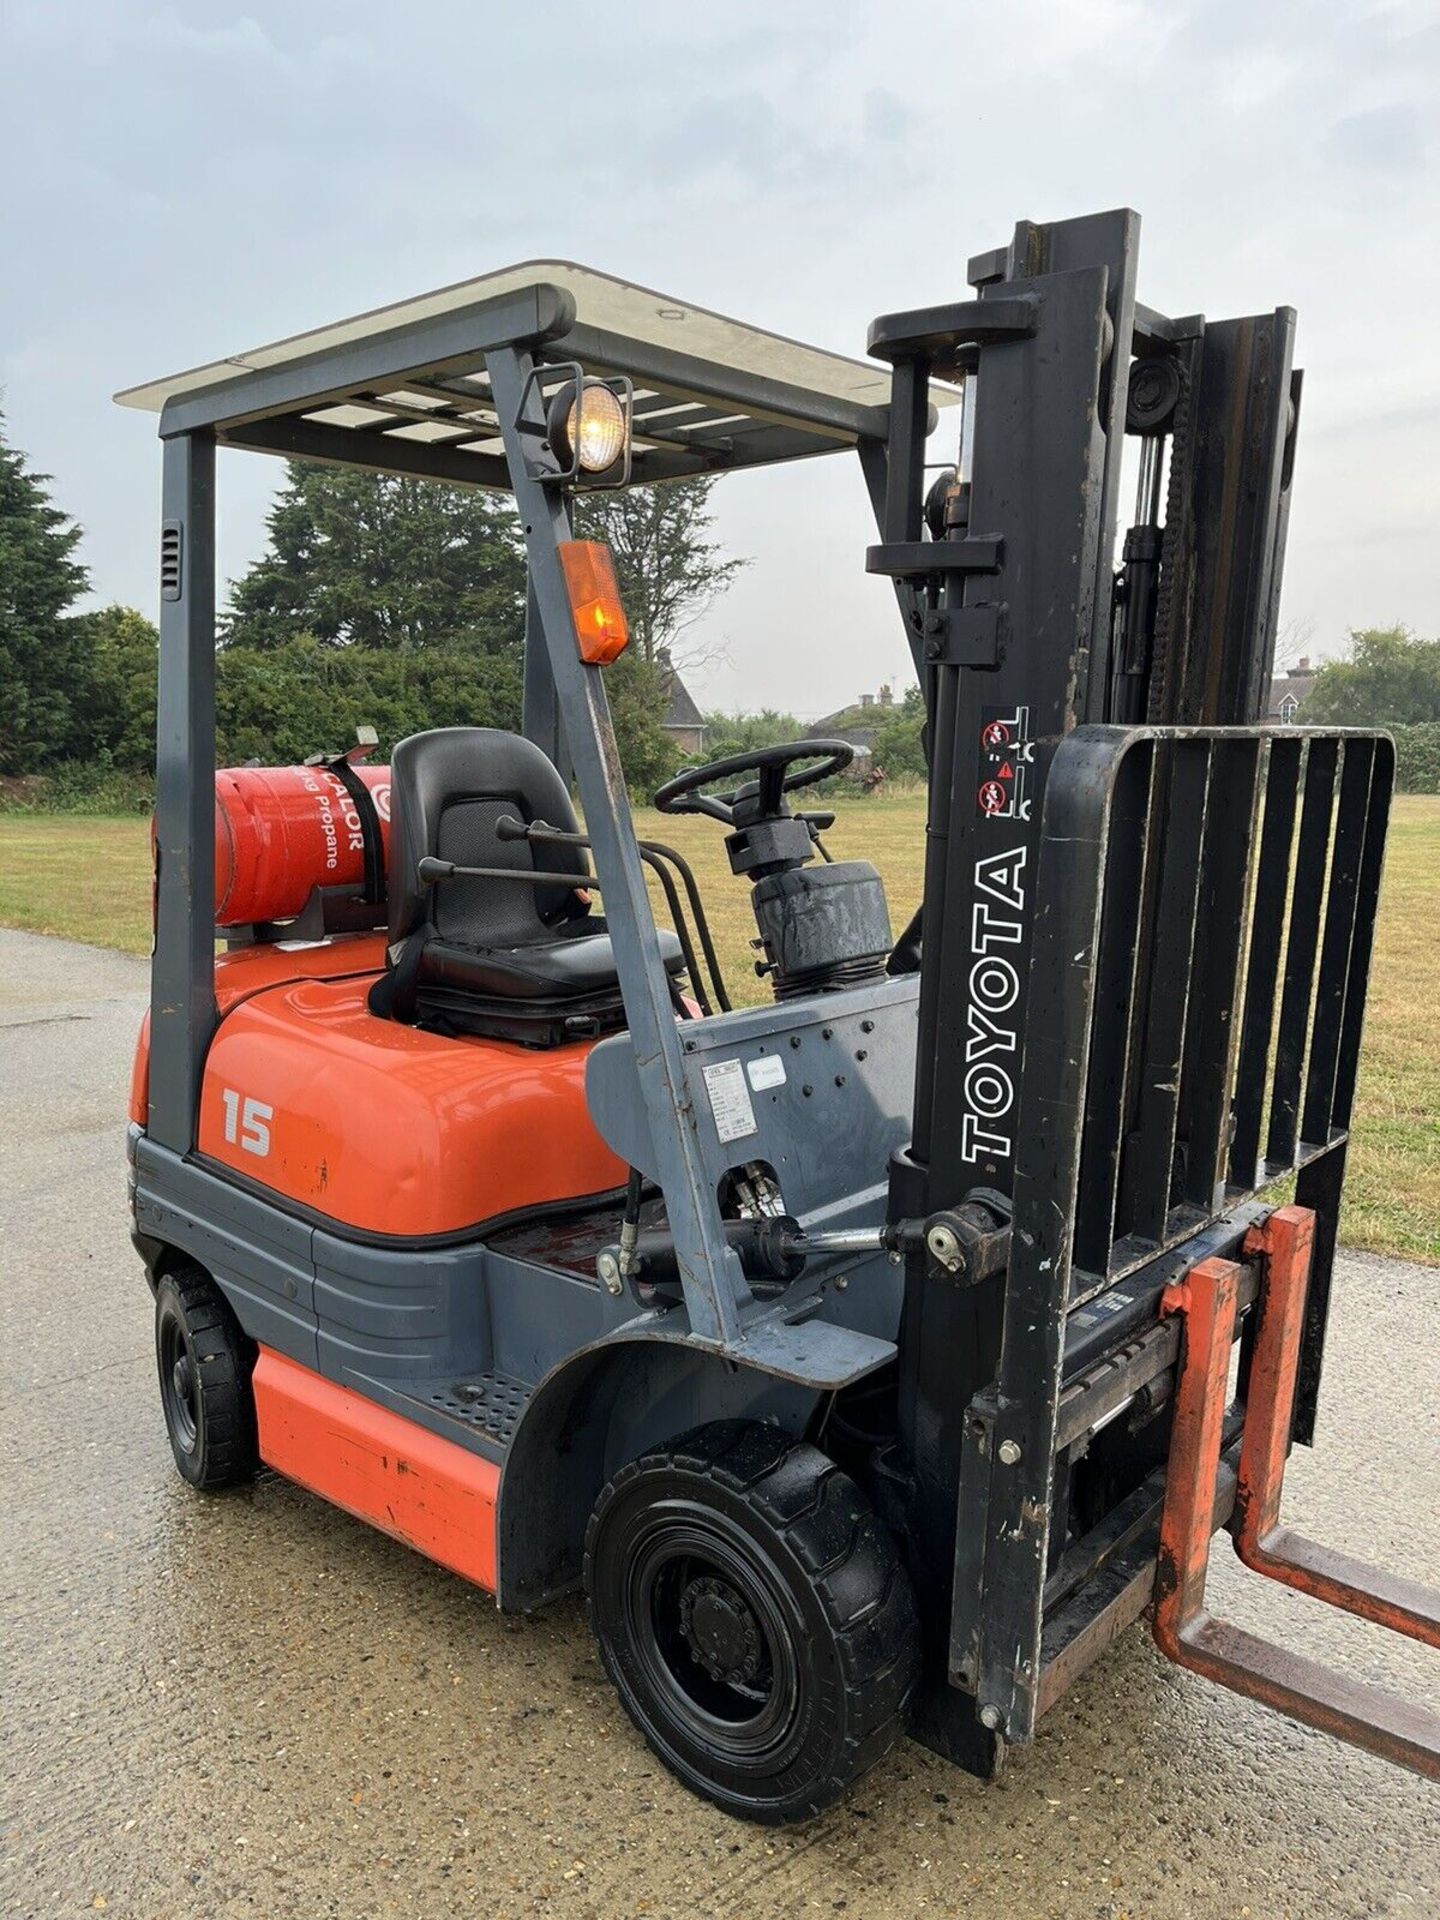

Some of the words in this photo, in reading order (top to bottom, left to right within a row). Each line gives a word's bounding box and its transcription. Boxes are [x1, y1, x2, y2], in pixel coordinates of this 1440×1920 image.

[314, 795, 338, 869] Propane
[320, 772, 365, 851] CALOR
[961, 845, 1028, 1164] TOYOTA
[222, 1087, 274, 1157] 15
